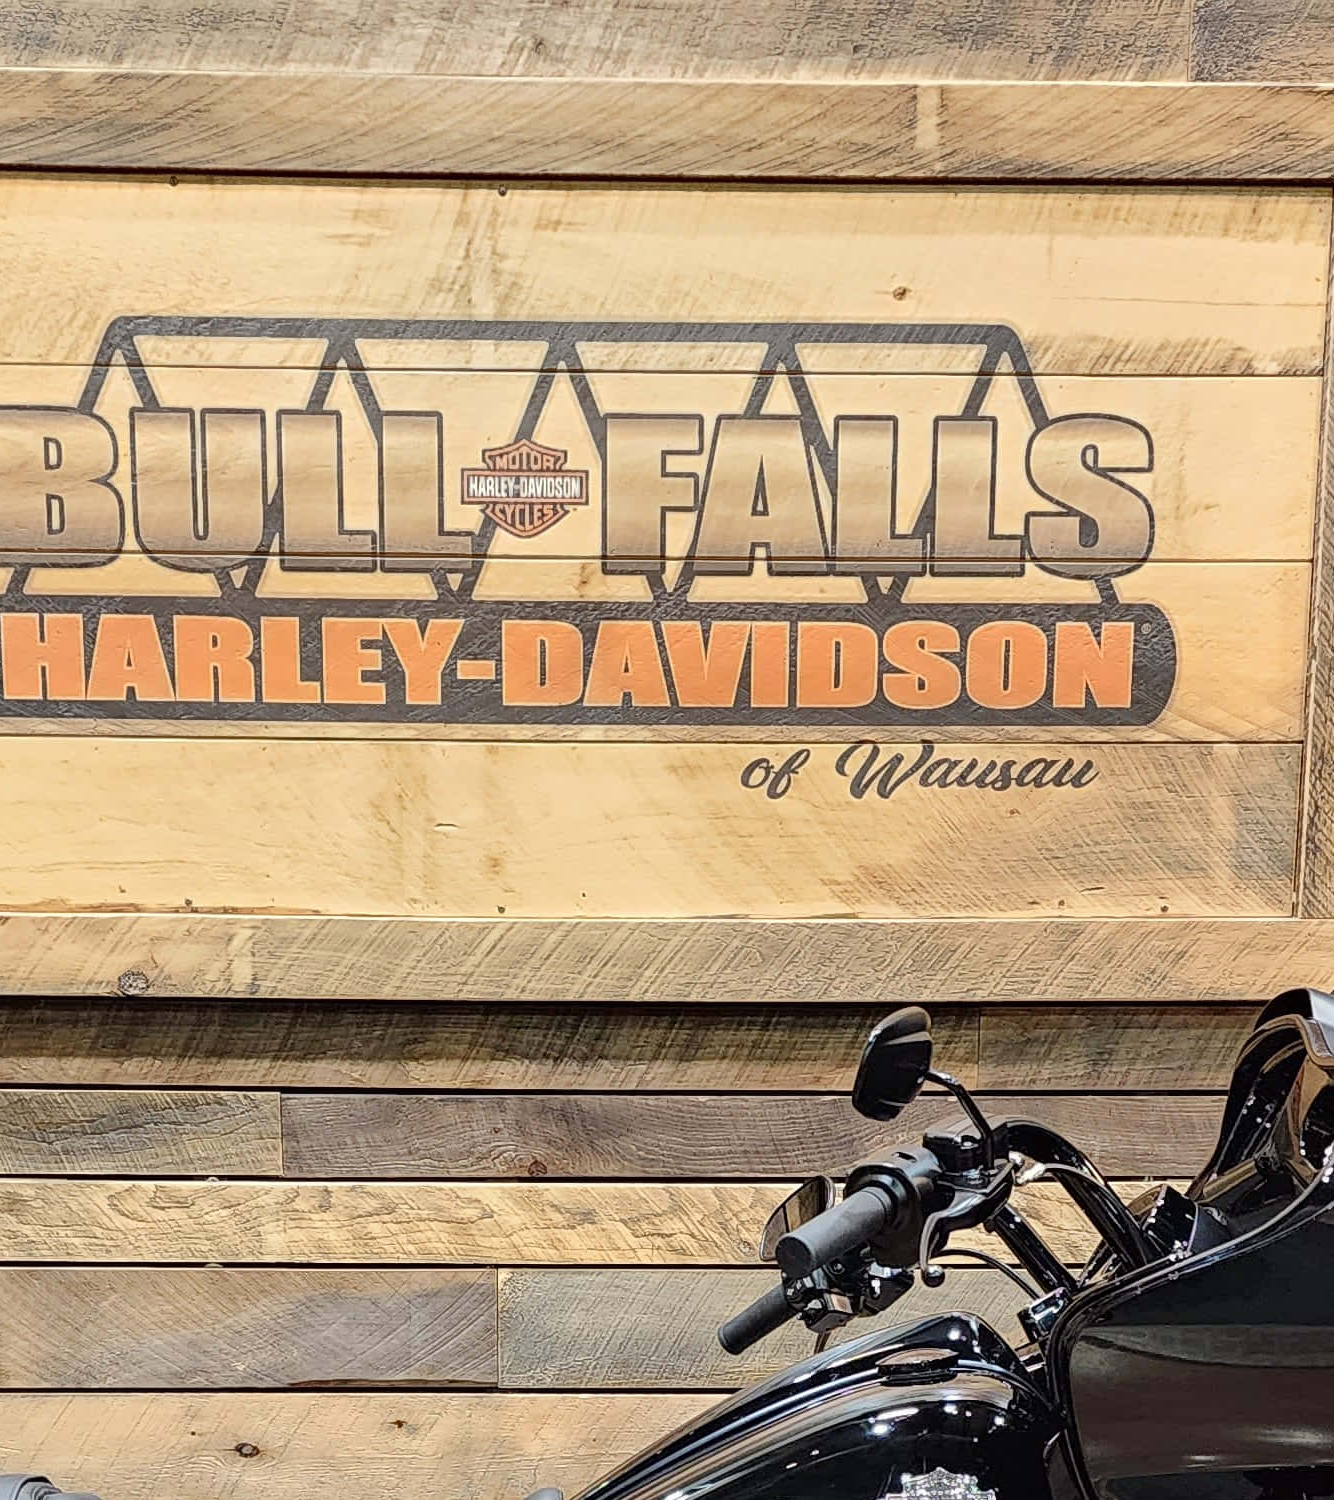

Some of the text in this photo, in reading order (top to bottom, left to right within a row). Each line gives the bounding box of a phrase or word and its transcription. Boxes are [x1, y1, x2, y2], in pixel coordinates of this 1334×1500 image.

[495, 448, 555, 471] MOTOR
[469, 475, 581, 499] HARLEY-DAVIDSON
[601, 413, 1155, 580] FALLS
[494, 504, 555, 531] CYCLES
[0, 612, 1134, 709] HARLEY-DAVIDSON
[740, 739, 1100, 800] of Wausau
